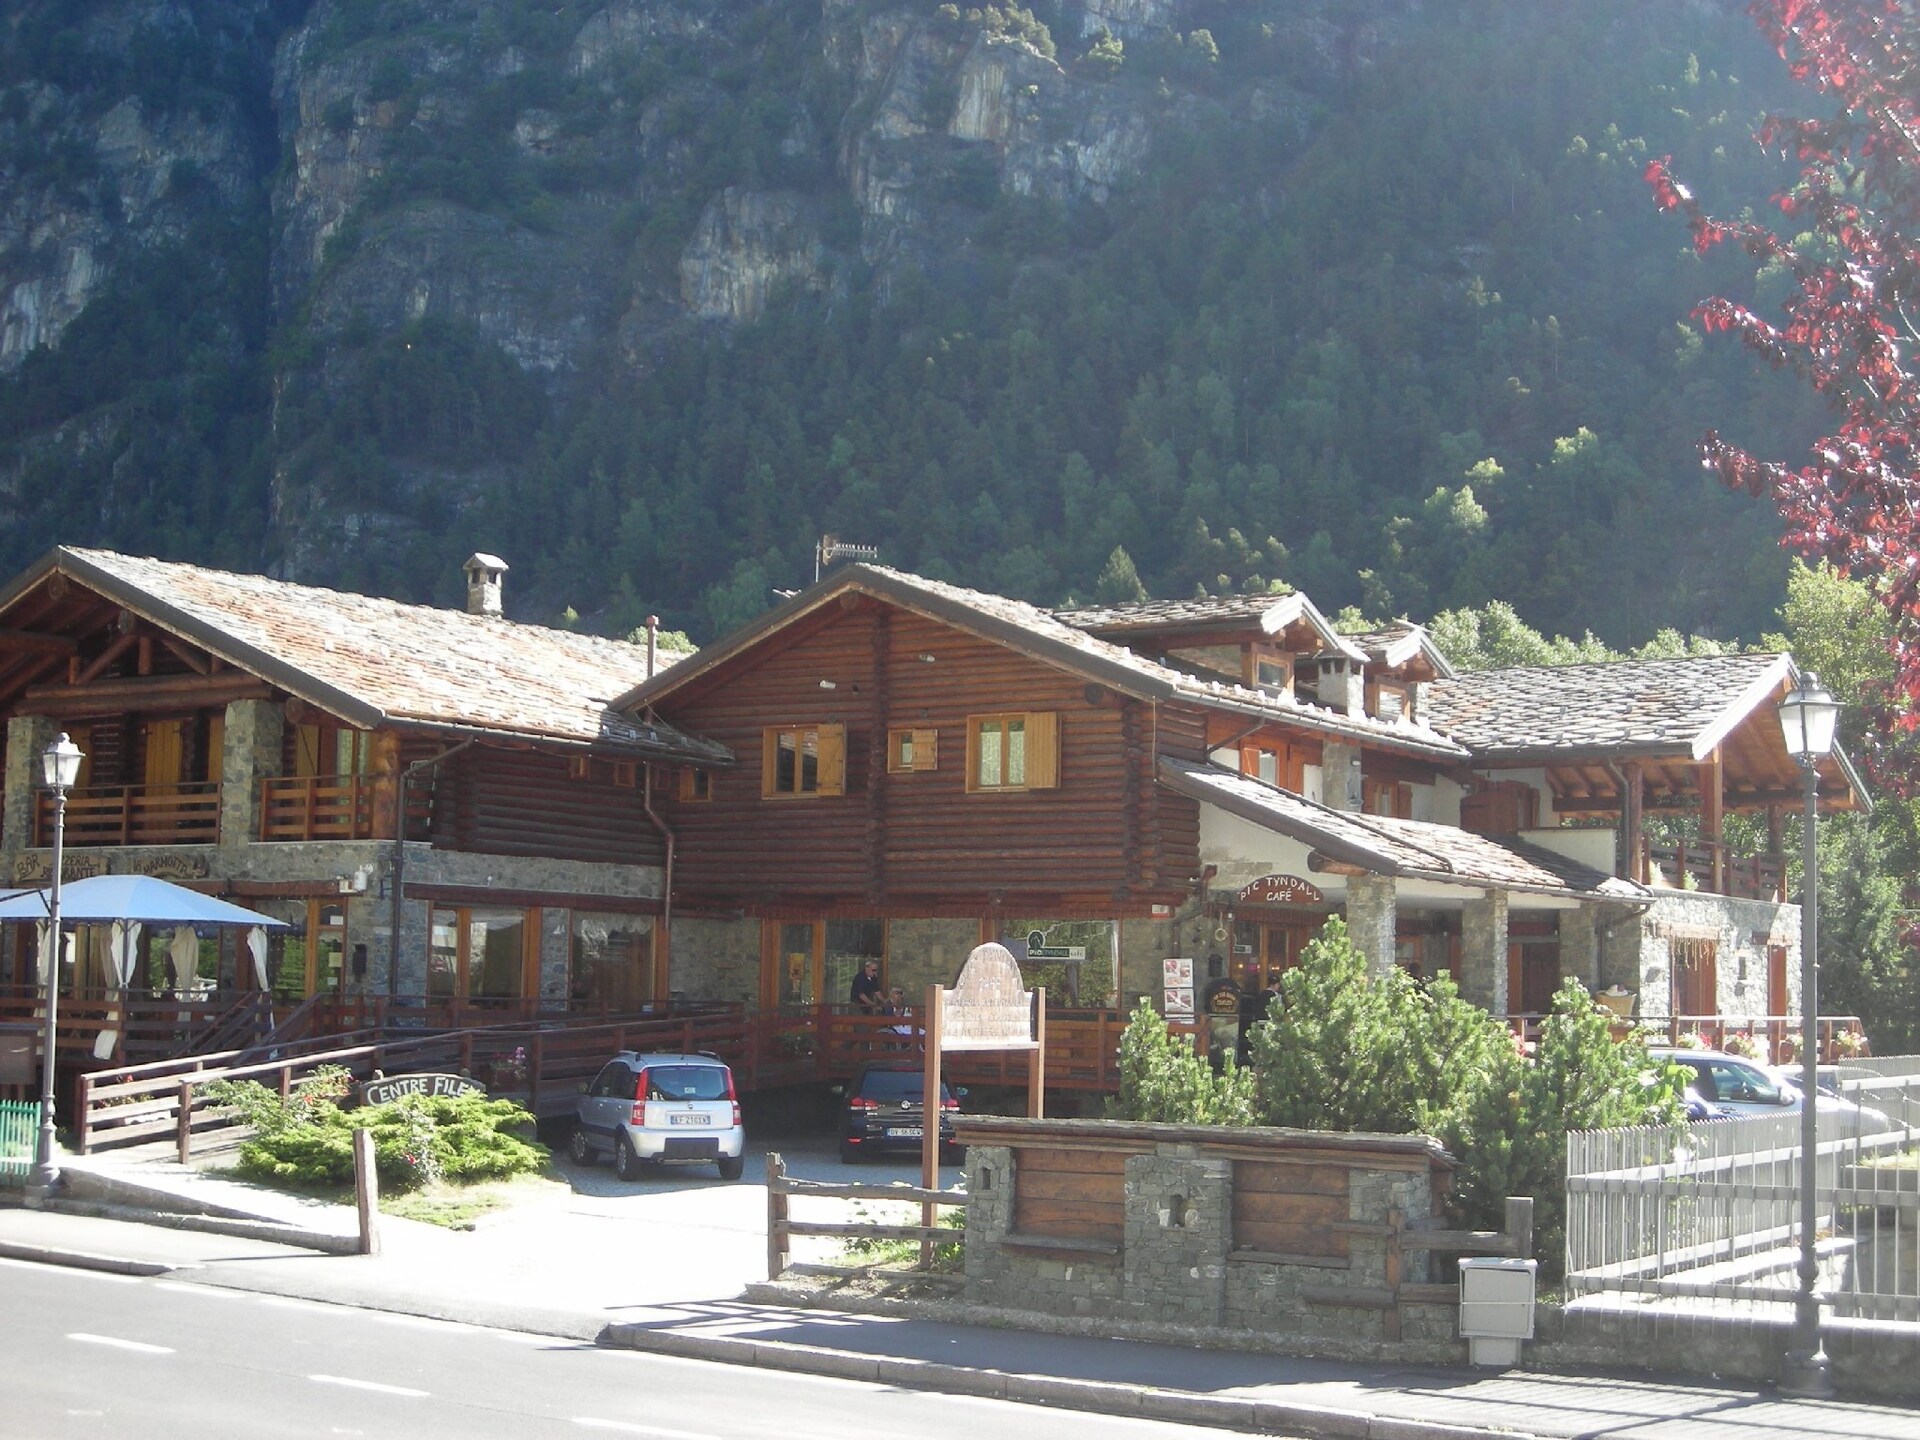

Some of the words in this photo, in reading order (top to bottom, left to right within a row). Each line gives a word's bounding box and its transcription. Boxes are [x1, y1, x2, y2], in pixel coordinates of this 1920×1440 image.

[17, 854, 40, 878] BAR
[60, 855, 91, 867] ZERIA
[1240, 881, 1260, 901] PIC
[1265, 877, 1320, 901] TYNDALL
[1266, 888, 1292, 901] CAFÉ
[367, 1078, 428, 1106] CENTRE
[433, 1076, 470, 1098] FILE
